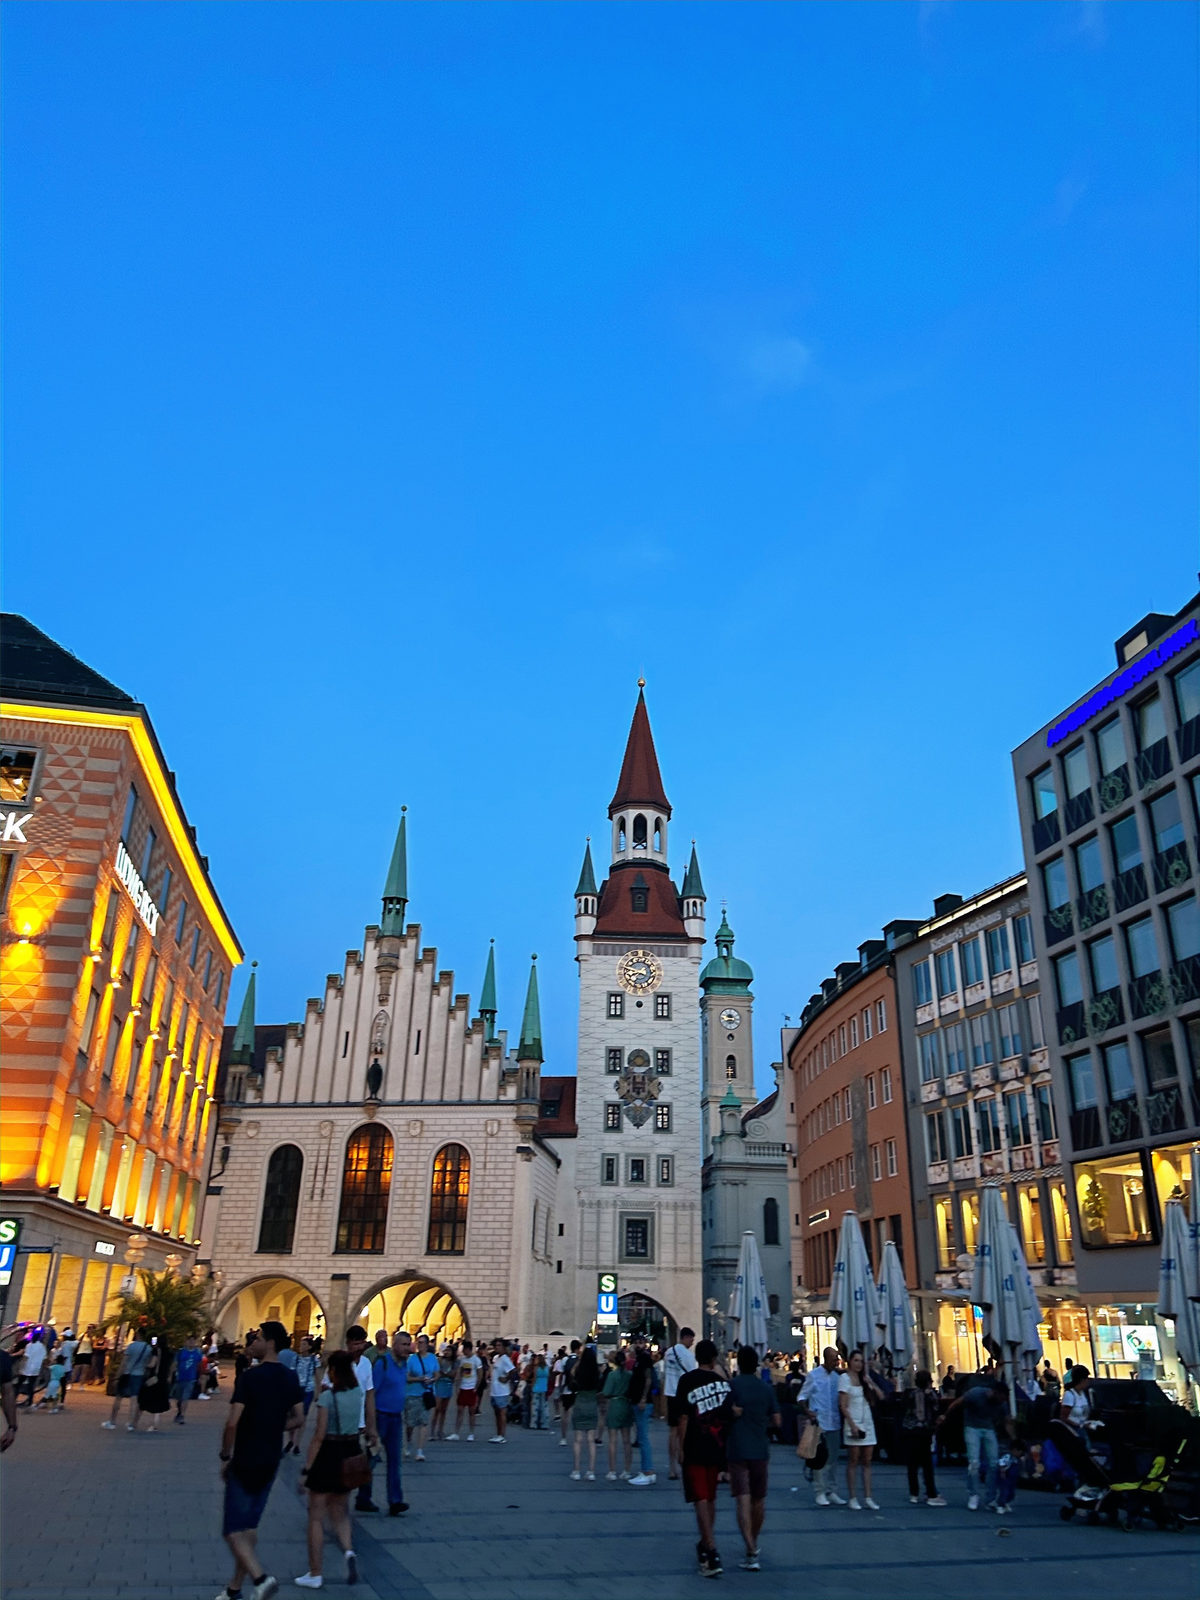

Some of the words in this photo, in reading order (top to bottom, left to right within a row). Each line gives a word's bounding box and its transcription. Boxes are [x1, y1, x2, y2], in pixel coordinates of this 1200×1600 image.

[0, 1220, 17, 1243] S
[601, 1274, 615, 1293] S
[601, 1295, 614, 1312] U
